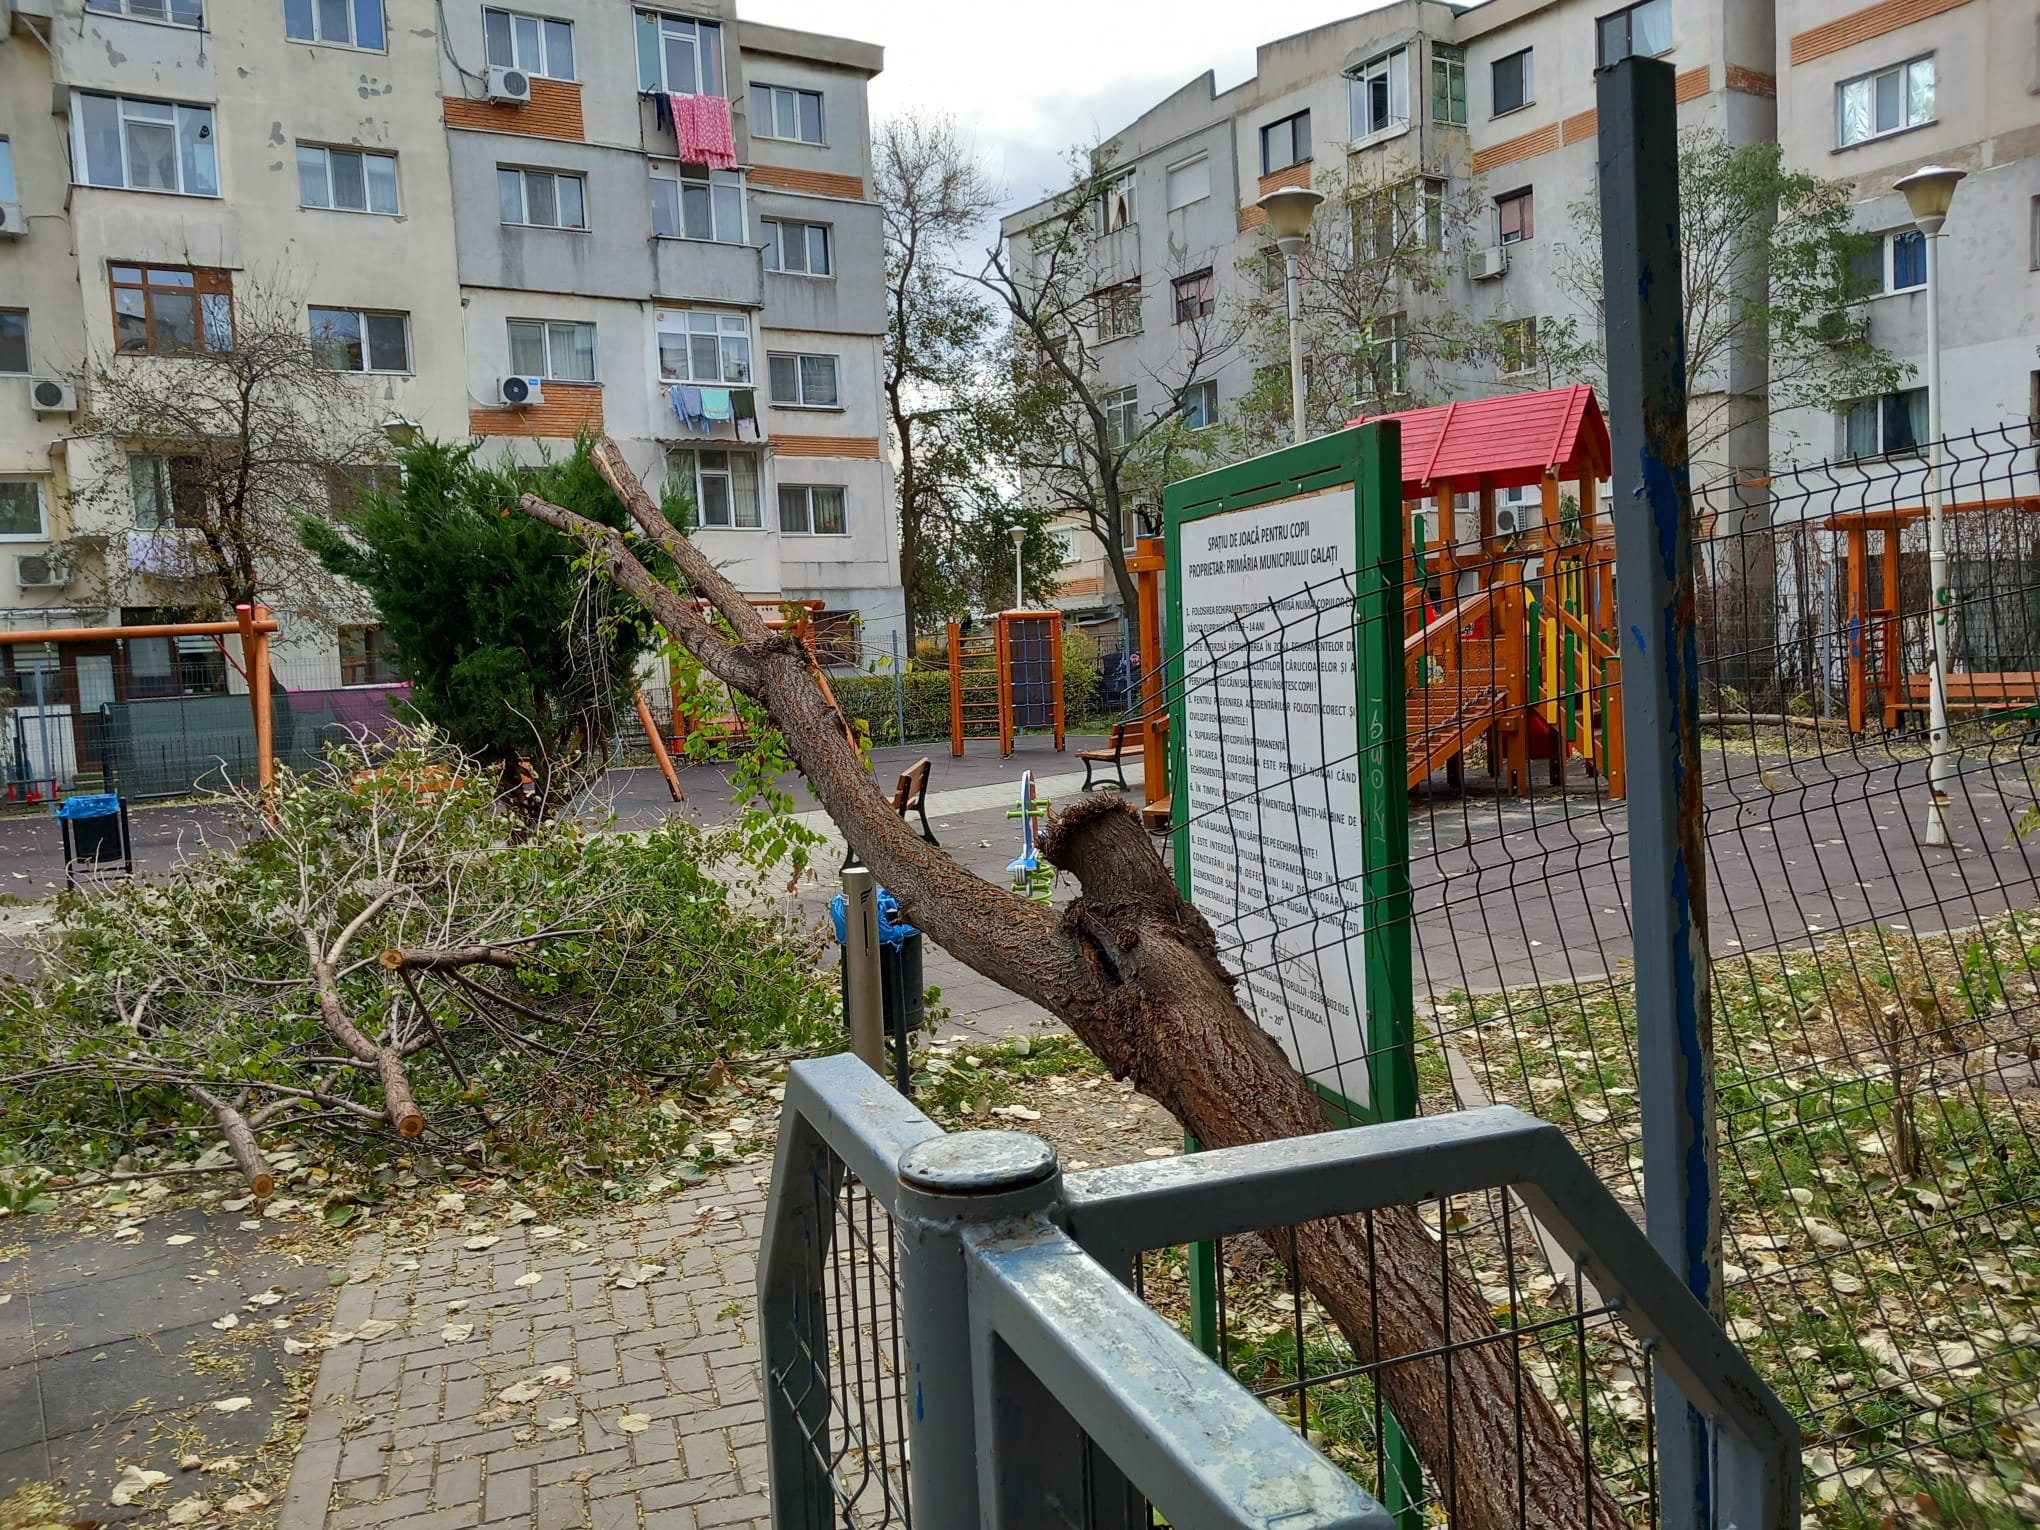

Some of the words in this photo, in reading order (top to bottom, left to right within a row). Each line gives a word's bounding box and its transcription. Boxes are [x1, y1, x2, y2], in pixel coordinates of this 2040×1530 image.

[1208, 534, 1228, 553] SPAȚIU
[1229, 532, 1238, 548] DE
[1239, 525, 1260, 547] JOACĂ
[1261, 524, 1289, 543] PENTRU
[1290, 520, 1310, 539] COPII
[1188, 560, 1226, 578] PROPRIETAR:
[1226, 553, 1258, 574] PRIMĂRIA
[1259, 548, 1309, 570] MUNICIPIULUI
[1310, 545, 1338, 566] GALAȚI
[1186, 606, 1191, 616] 1.
[1270, 598, 1295, 612] RMISĂ
[1295, 599, 1317, 610] NUMA
[1228, 620, 1242, 632] ÎNTR
[1204, 641, 1227, 652] ITERZISĂ
[1273, 642, 1289, 652] ZOA
[1211, 659, 1239, 671] ȘINILOR
[1285, 659, 1338, 672] CĂRUCIOAELOR
[1340, 662, 1347, 675] ȘI
[1263, 679, 1271, 690] NU
[1193, 695, 1212, 705] PENTRU
[1213, 696, 1244, 708] PEVENIREA
[1245, 698, 1290, 711] ACIDENTĂRILR
[1322, 703, 1346, 716] CORECT
[1349, 706, 1355, 719] ȘI
[1208, 713, 1246, 726] ECHIAMENTELE
[1194, 730, 1229, 744] SUPRAVEGHAȚI
[1250, 738, 1286, 752] PRMANENȚĂ
[1190, 764, 1223, 779] ECHIPAMENTEL
[1194, 749, 1218, 761] URCAREA
[1227, 753, 1260, 768] COBORÂRA
[1262, 759, 1276, 770] ESTE
[1336, 768, 1357, 783] CÂND
[1202, 785, 1220, 797] TIMPUL
[1248, 795, 1295, 813] ECHPAMENTELOR
[1348, 815, 1357, 827] DE
[1225, 807, 1248, 822] OTECȚIE
[1209, 821, 1233, 836] BALANSA
[1246, 830, 1260, 844] SĂRIȚ
[1197, 836, 1208, 847] ESTE
[1209, 840, 1234, 855] INTERZISĂ
[1237, 848, 1266, 864] UTILIZARA
[1193, 851, 1225, 869] CONSTATĂRII
[1245, 868, 1279, 887] DEFECIUNI
[1281, 879, 1294, 892] SAU
[1296, 884, 1341, 908] DEERIORĂRI
[1231, 897, 1251, 912] TEEFON
[1286, 900, 1308, 917] RUGĂM
[1322, 912, 1358, 934] CONTATAȚI
